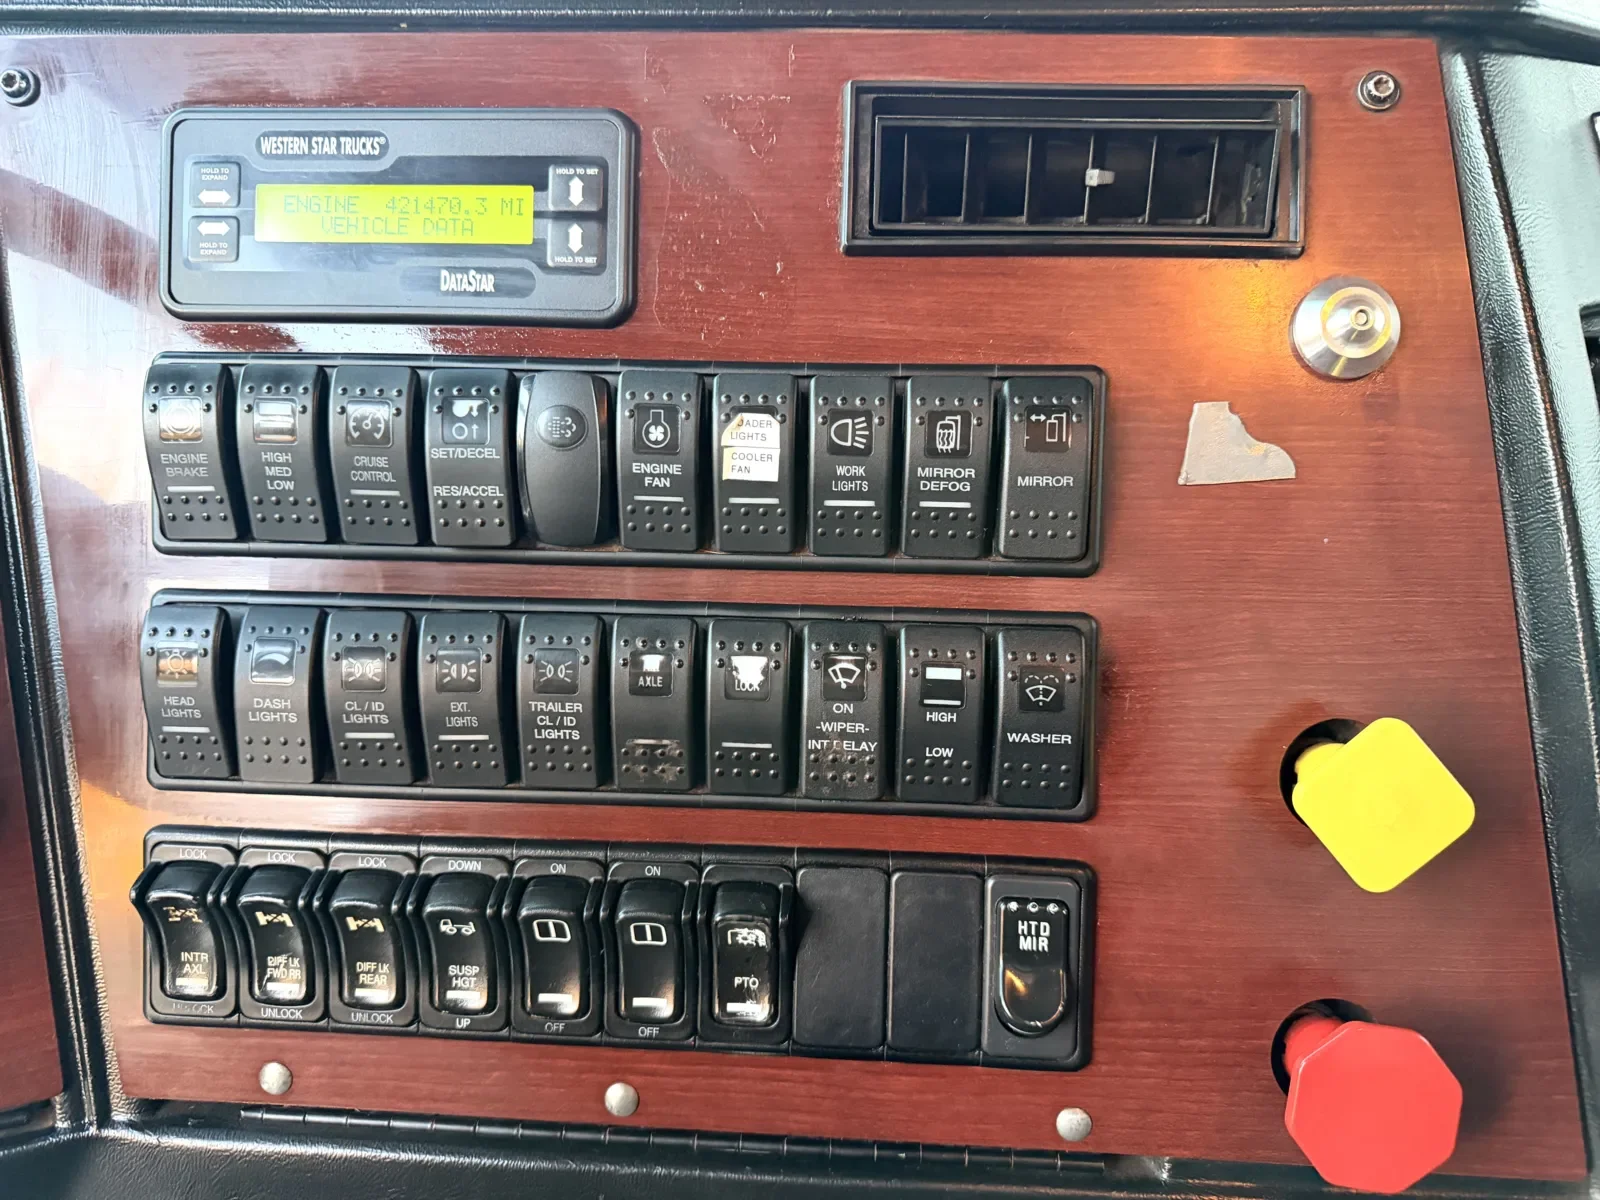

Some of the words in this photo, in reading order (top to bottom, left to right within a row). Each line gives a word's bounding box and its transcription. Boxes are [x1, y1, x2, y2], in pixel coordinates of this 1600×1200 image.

[260, 136, 310, 155] WESTERN
[311, 136, 337, 155] STAR
[284, 195, 360, 214] ENGINE
[386, 196, 487, 215] 421470.3
[501, 198, 524, 216] MI
[322, 216, 408, 235] VEHICLE
[423, 218, 474, 236] DATA
[730, 432, 767, 441] LIGHTS
[160, 453, 208, 464] ENGINE
[261, 452, 292, 463] HIGH
[431, 448, 500, 459] SET/DECEL
[731, 452, 773, 462] COOLER
[354, 456, 389, 468] CRUISE
[166, 467, 209, 477] BRAKE
[265, 466, 292, 476] MED
[632, 463, 682, 475] ENGINE
[731, 465, 750, 474] FAN
[836, 465, 866, 477] WORK
[917, 467, 976, 478] MIRROR
[351, 470, 396, 483] CONTROL
[644, 477, 670, 487] FAN
[1017, 476, 1073, 487] MIRROR
[267, 480, 294, 490] LOW
[832, 481, 868, 492] LIGHTS
[920, 481, 971, 491] DEFOG
[433, 486, 504, 496] RES/ACCEL
[638, 676, 663, 688] AXLE
[164, 696, 195, 706] HEAD
[253, 698, 291, 709] DASH
[450, 702, 471, 712] EXT.
[528, 701, 583, 713] TRAILER
[832, 703, 854, 714] ON
[162, 708, 201, 718] LIGHTS
[249, 711, 298, 723] LIGHTS
[926, 712, 957, 722] HIGH
[343, 714, 389, 724] LIGHTS
[446, 717, 478, 727] LIGHTS
[534, 729, 580, 740] LIGHTS
[1007, 733, 1072, 744] WASHER
[808, 740, 830, 750] INT
[926, 747, 953, 758] LOW
[179, 848, 207, 859] LOCK
[267, 852, 295, 863] LOCK
[358, 857, 387, 868] LOCK
[449, 860, 481, 871] DOWN
[550, 863, 566, 873] ON
[645, 866, 661, 876] ON
[1018, 920, 1050, 937] HTD
[1019, 936, 1049, 952] MIR
[181, 952, 208, 962] INTR
[289, 957, 300, 967] LK
[183, 964, 206, 974] AXL
[356, 962, 377, 973] DIFF
[378, 963, 389, 973] LK
[449, 965, 480, 976] SUSP
[267, 968, 287, 978] FWD
[289, 969, 301, 979] RR
[359, 974, 387, 985] REAR
[452, 976, 477, 988] HGT
[734, 976, 759, 989] PTO
[261, 1008, 302, 1019] UNLOCK
[351, 1012, 393, 1024] UNLOCK
[456, 1018, 471, 1028] UP
[545, 1022, 565, 1032] OFF
[638, 1026, 660, 1037] OFF
